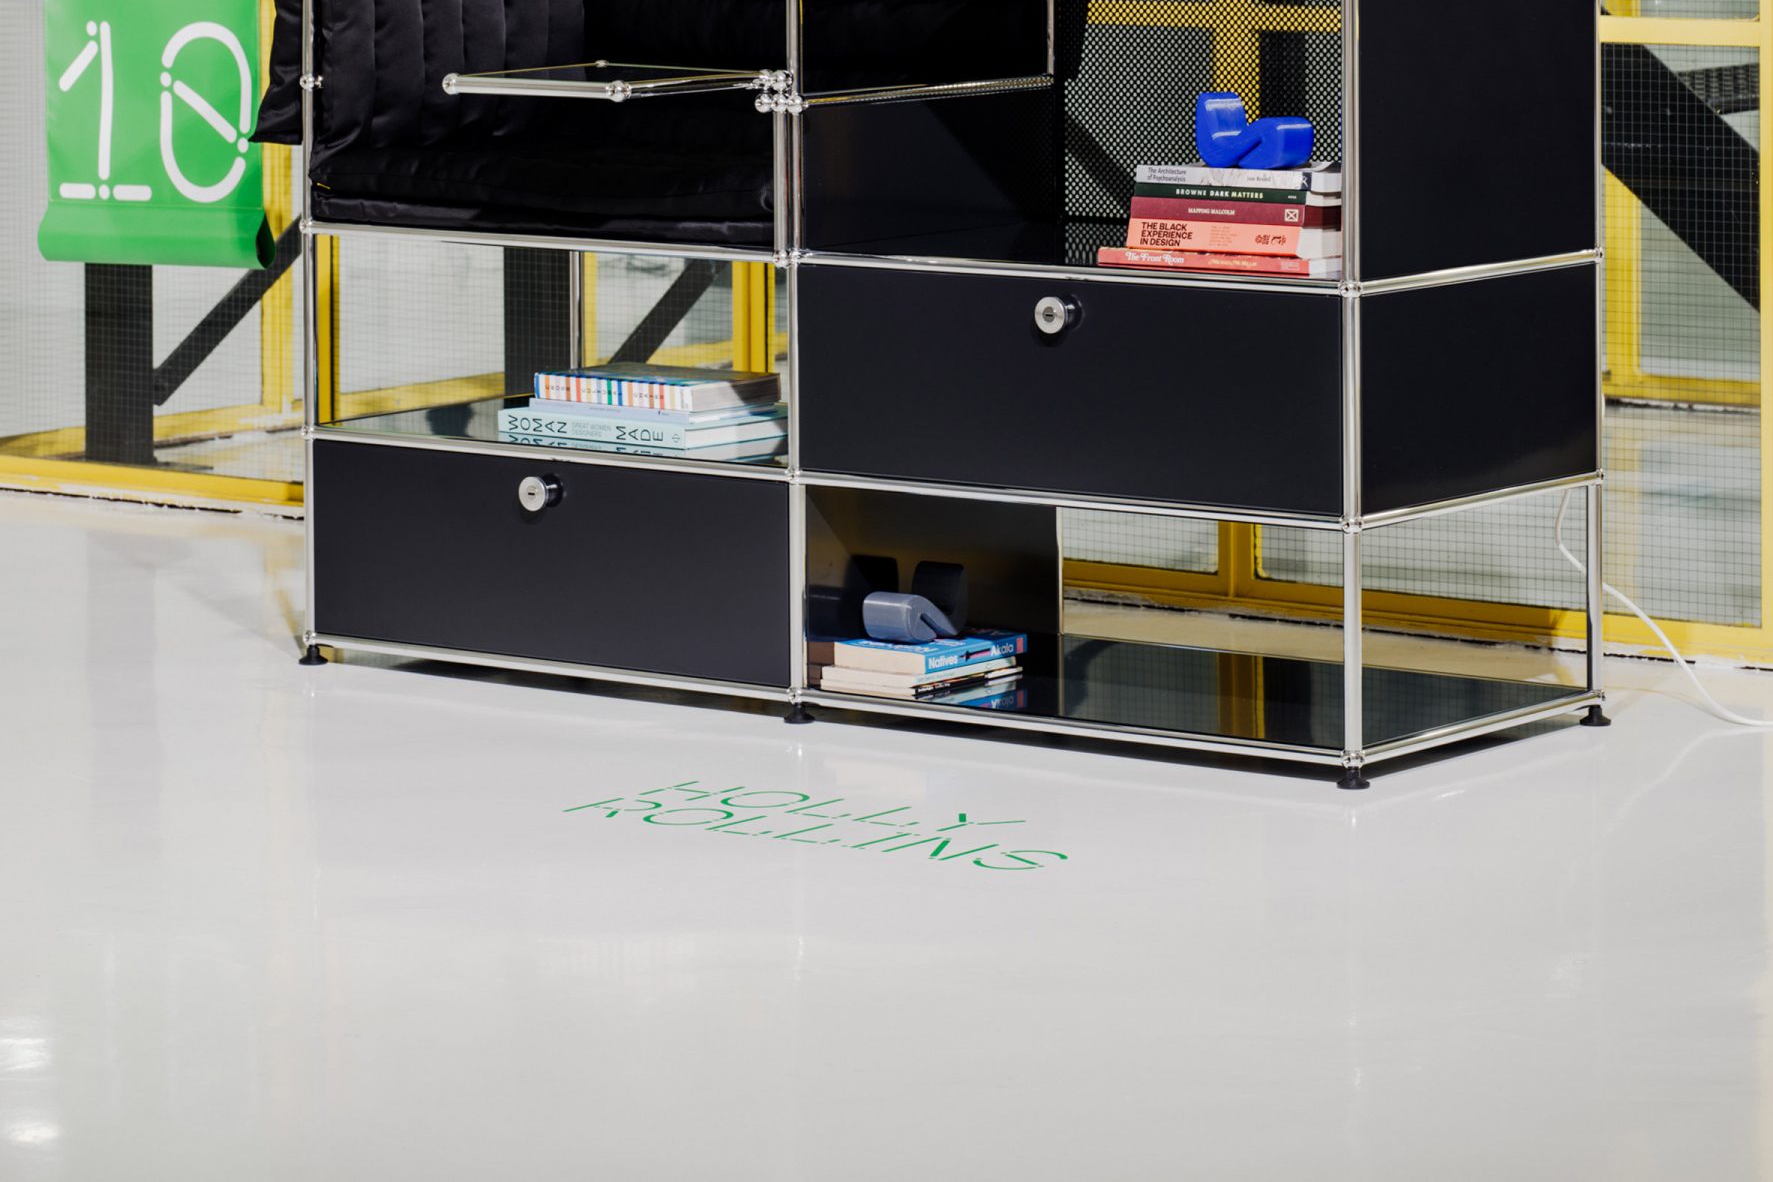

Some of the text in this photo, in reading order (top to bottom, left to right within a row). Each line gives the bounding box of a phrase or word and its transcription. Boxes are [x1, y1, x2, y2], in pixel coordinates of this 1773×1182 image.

[58, 19, 252, 203] 10
[1147, 166, 1187, 175] The Architecture
[1147, 173, 1153, 181] of
[1175, 188, 1207, 196] BROWNE
[1230, 191, 1264, 199] MATTERS
[1141, 221, 1188, 232] THE BLACK
[1139, 237, 1181, 247] IN DESIGN
[1141, 229, 1193, 240] EXPERIENCE
[1125, 251, 1185, 266] The Front Room
[507, 413, 568, 434] WOMAN
[615, 424, 665, 442] MADE
[928, 643, 1014, 669] Natives Akala
[638, 780, 1027, 832] HOLLY
[562, 797, 1069, 871] ROLLINS
